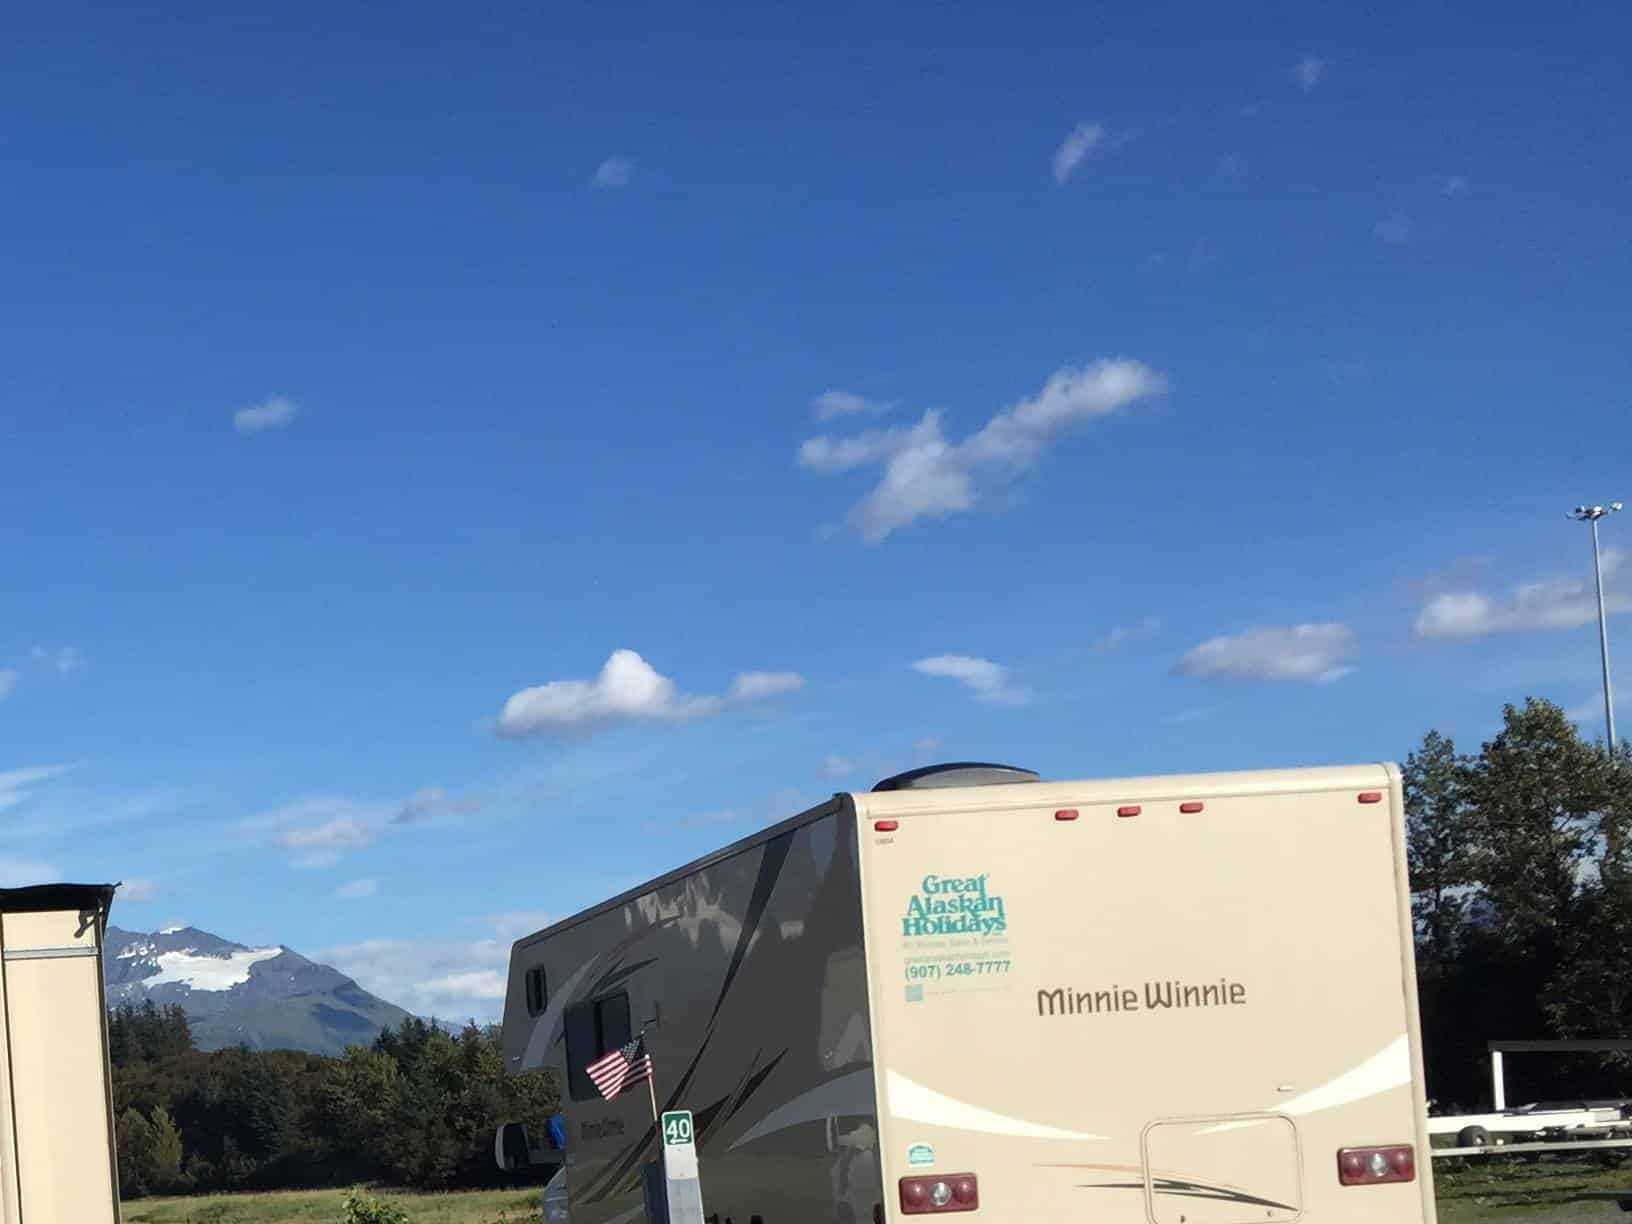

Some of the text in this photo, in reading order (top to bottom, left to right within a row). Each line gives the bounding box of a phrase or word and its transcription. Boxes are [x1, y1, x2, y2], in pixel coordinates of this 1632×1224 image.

[922, 873, 986, 899] Great
[907, 894, 1005, 921] Alaskan
[901, 914, 1007, 936] Holidays
[905, 960, 1010, 981] (907) 248-7777
[1037, 978, 1246, 1016] Minnie Winnie
[667, 1118, 690, 1138] 40
